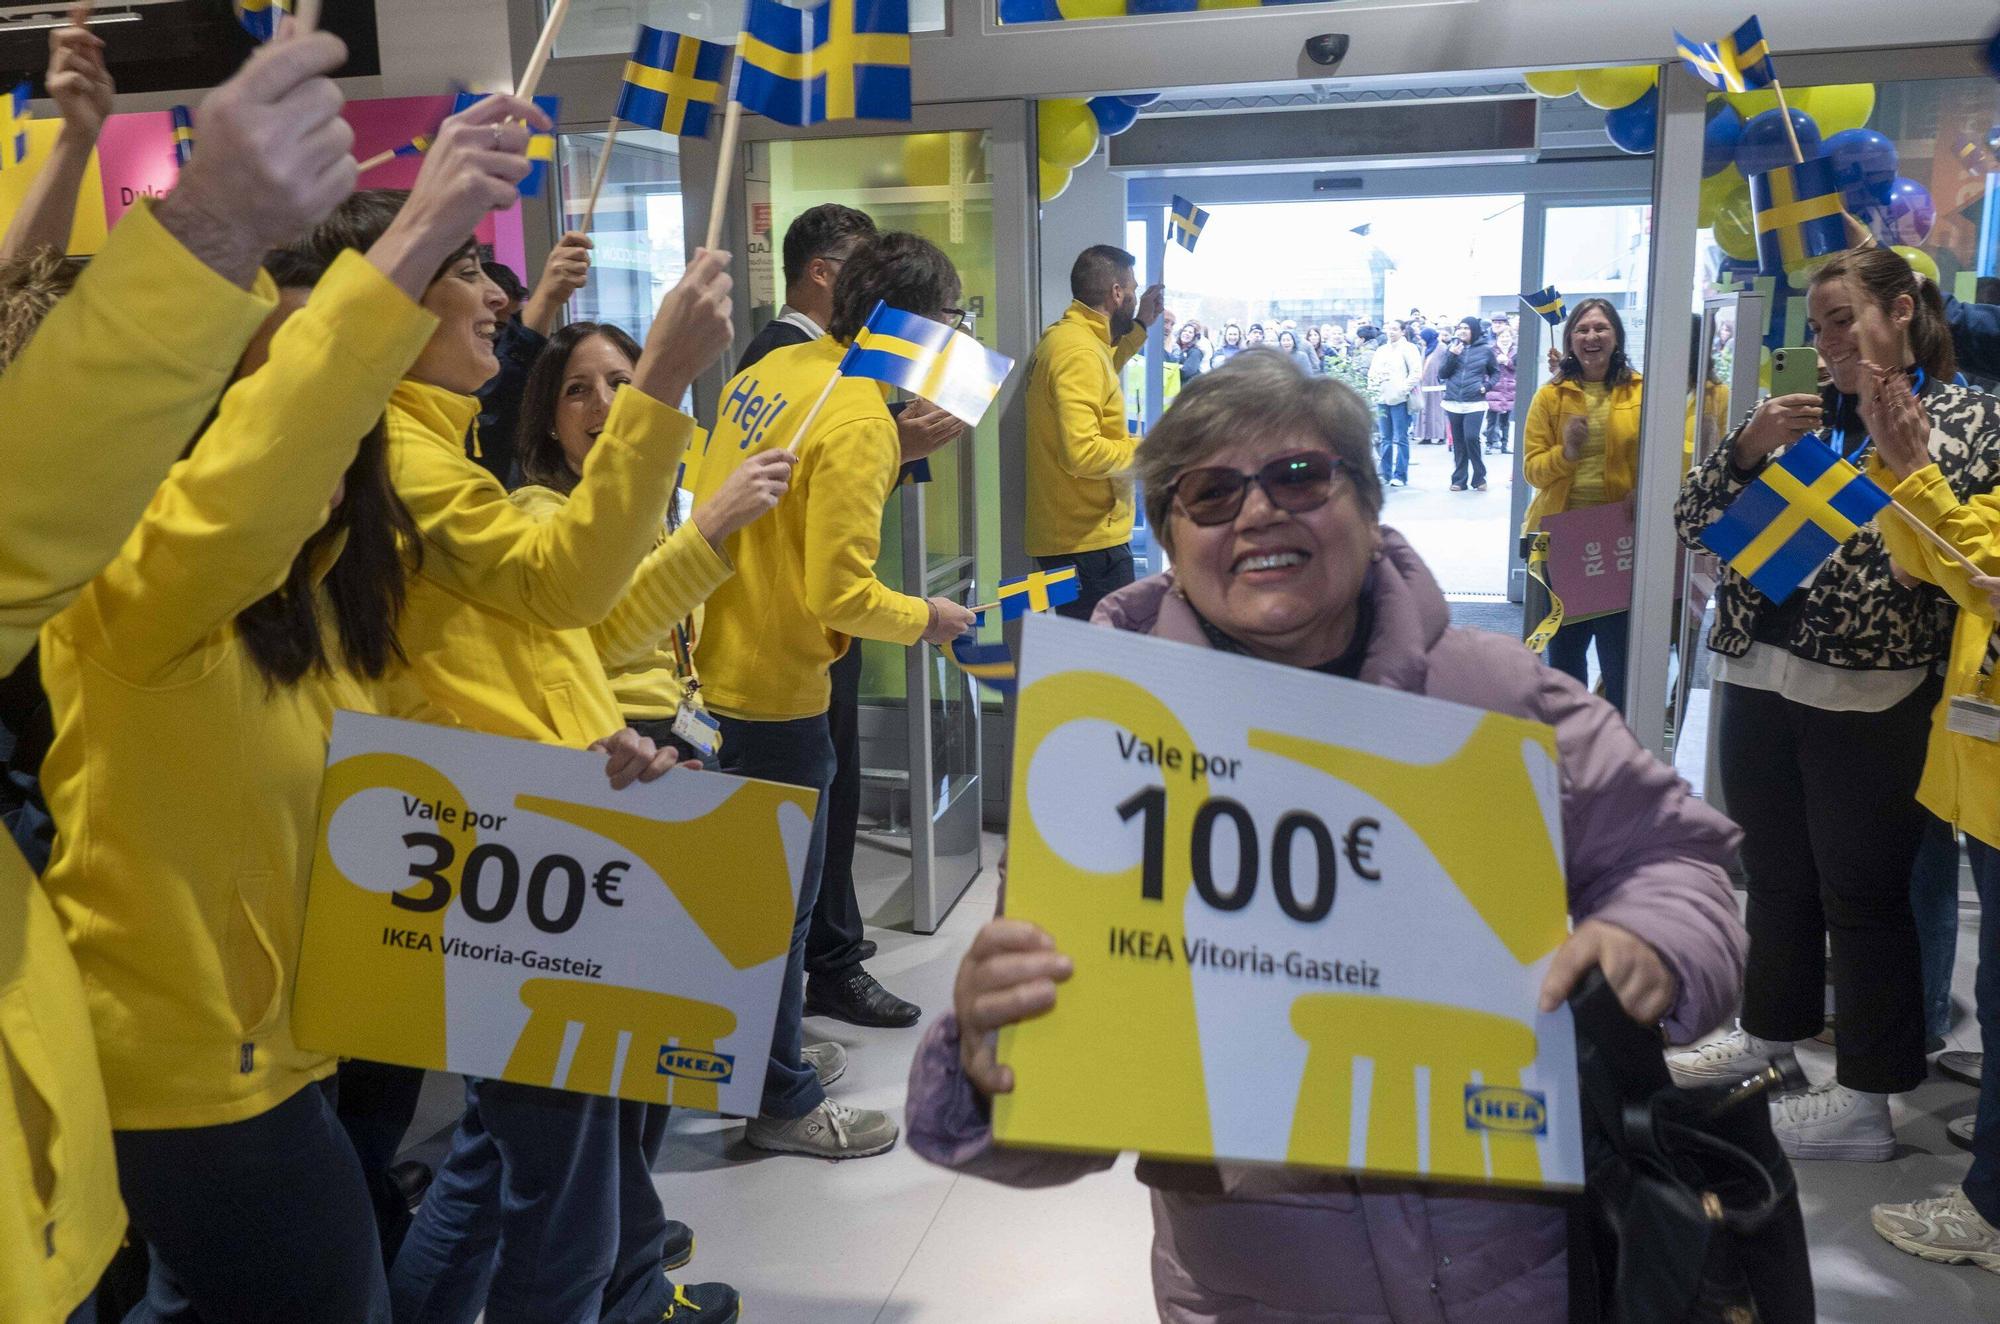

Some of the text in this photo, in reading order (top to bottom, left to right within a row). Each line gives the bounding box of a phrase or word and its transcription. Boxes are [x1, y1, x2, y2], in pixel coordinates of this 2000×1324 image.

[722, 375, 788, 449] Hej!
[1582, 542, 1605, 577] Ríe
[1613, 536, 1633, 572] Ríe
[1116, 731, 1242, 781] Vale por
[402, 796, 508, 832] Vale por
[1115, 783, 1382, 923] 100€
[390, 831, 632, 934] 300€
[382, 927, 603, 979] IKEA Vitoria-Gasteiz
[1109, 927, 1381, 988] IKEA Vitoria-Gasteiz
[666, 1054, 726, 1074] IKEA
[1474, 1097, 1538, 1120] IKEA
